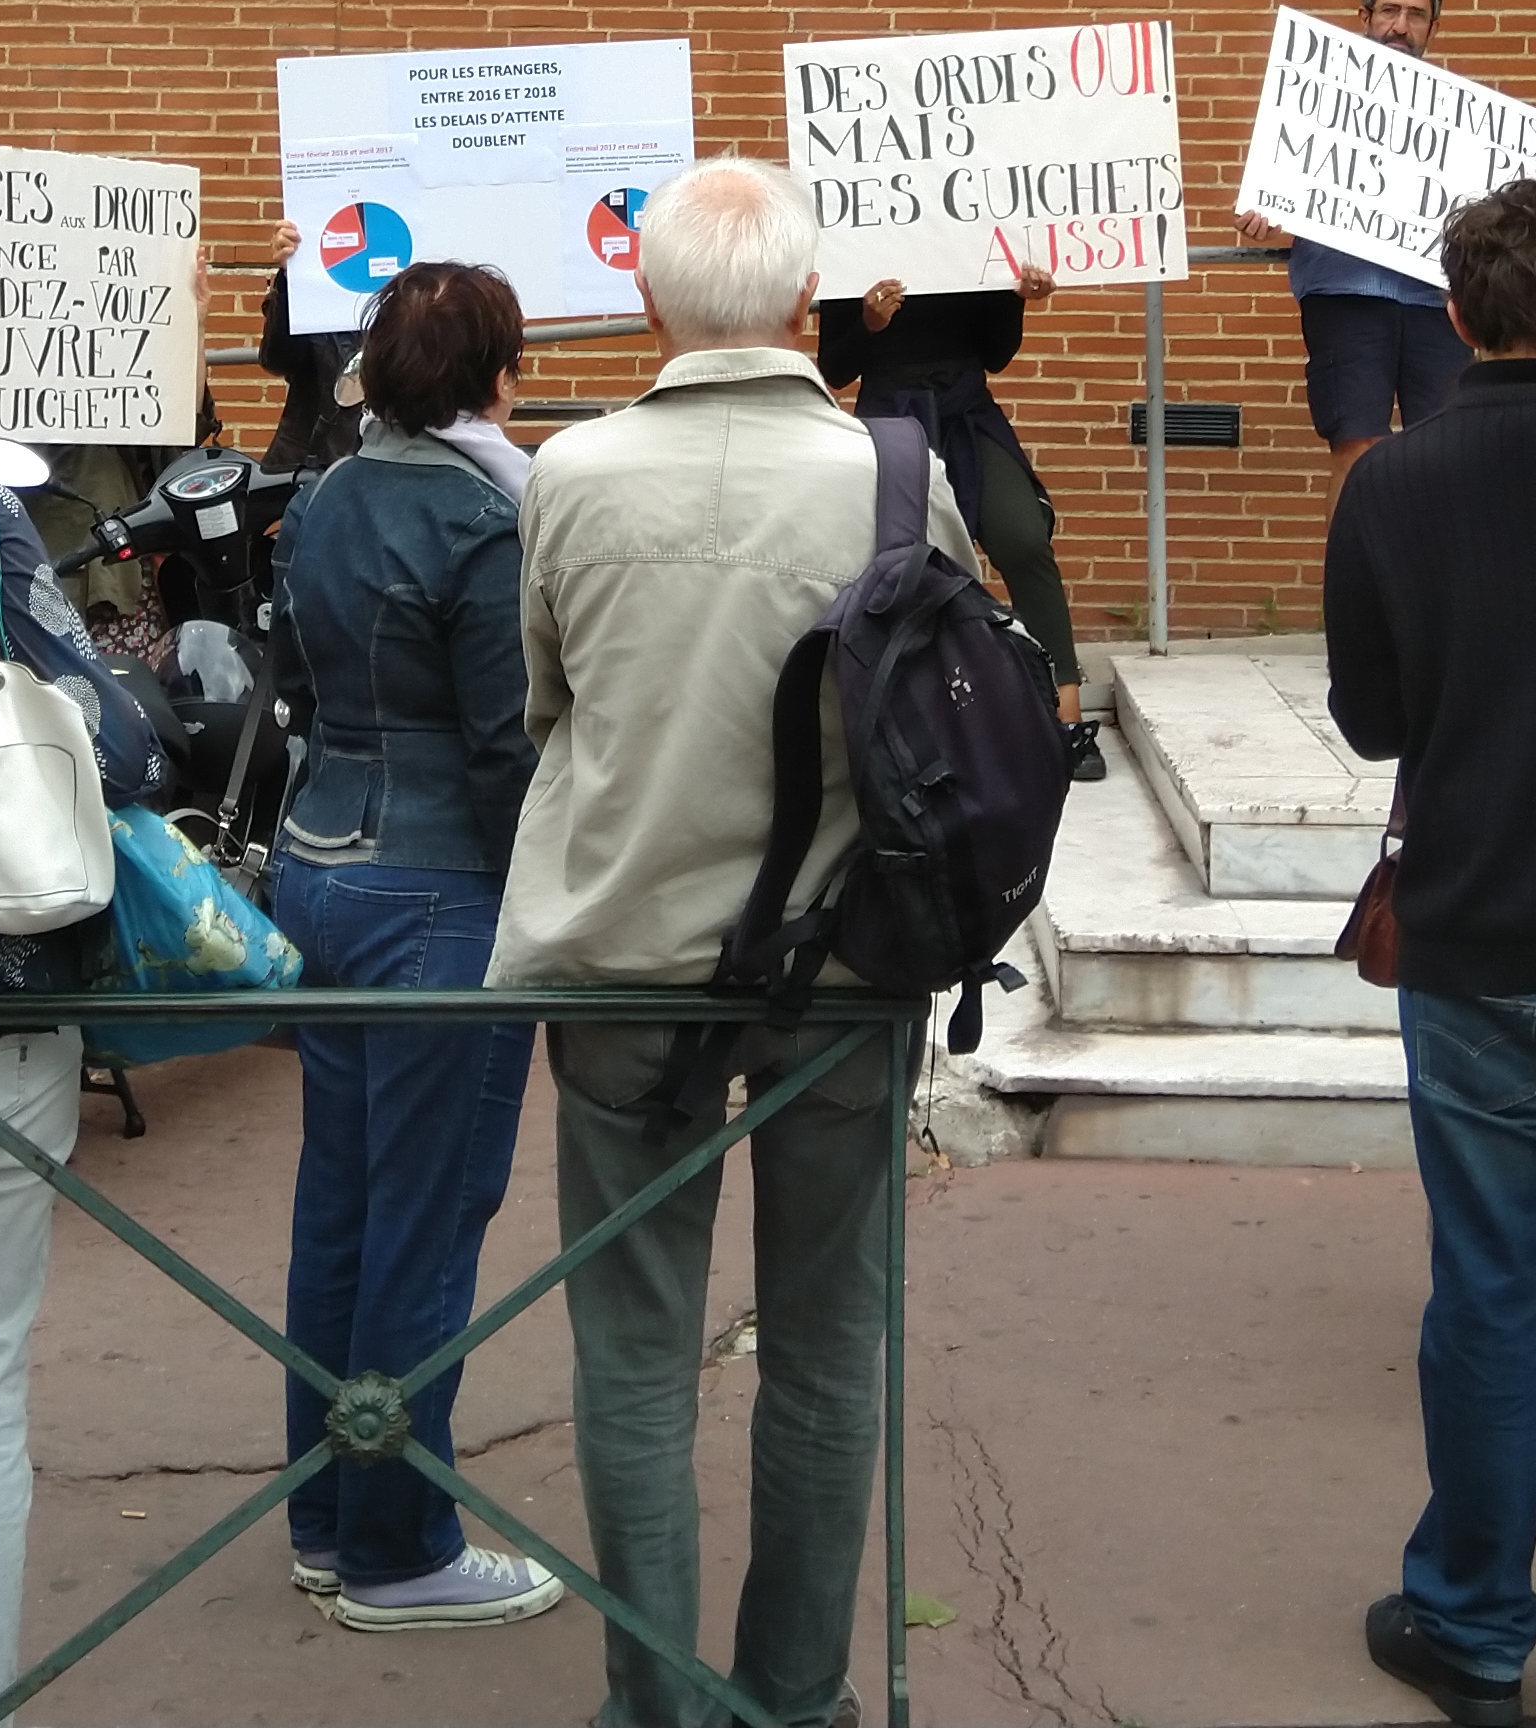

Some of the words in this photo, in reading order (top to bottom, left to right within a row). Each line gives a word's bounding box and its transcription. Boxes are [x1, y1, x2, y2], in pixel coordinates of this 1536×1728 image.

[409, 68, 448, 82] POUR
[452, 66, 474, 79] LES
[478, 62, 562, 78] ETRANGERS,
[795, 62, 888, 115] DES
[914, 45, 1057, 108] ORDIS
[421, 91, 464, 104] ENTRE
[468, 89, 500, 102] 2016
[505, 87, 520, 100] ET
[524, 86, 556, 99] 2018
[414, 115, 437, 129] LES
[440, 112, 487, 127] DELAIS
[491, 108, 565, 125] D'ATTENTE
[808, 107, 975, 166] MAIS
[1274, 65, 1451, 172] POURQUOI
[452, 133, 526, 149] DOUBLENT
[1274, 122, 1386, 197] MAIS
[810, 174, 921, 229] DES
[943, 154, 1183, 222] GUICHETS
[1257, 189, 1296, 214] DES
[60, 215, 86, 229] AUX
[93, 185, 197, 239] DROITS
[98, 246, 138, 277] PAR
[1001, 864, 1039, 904] TIGHT
